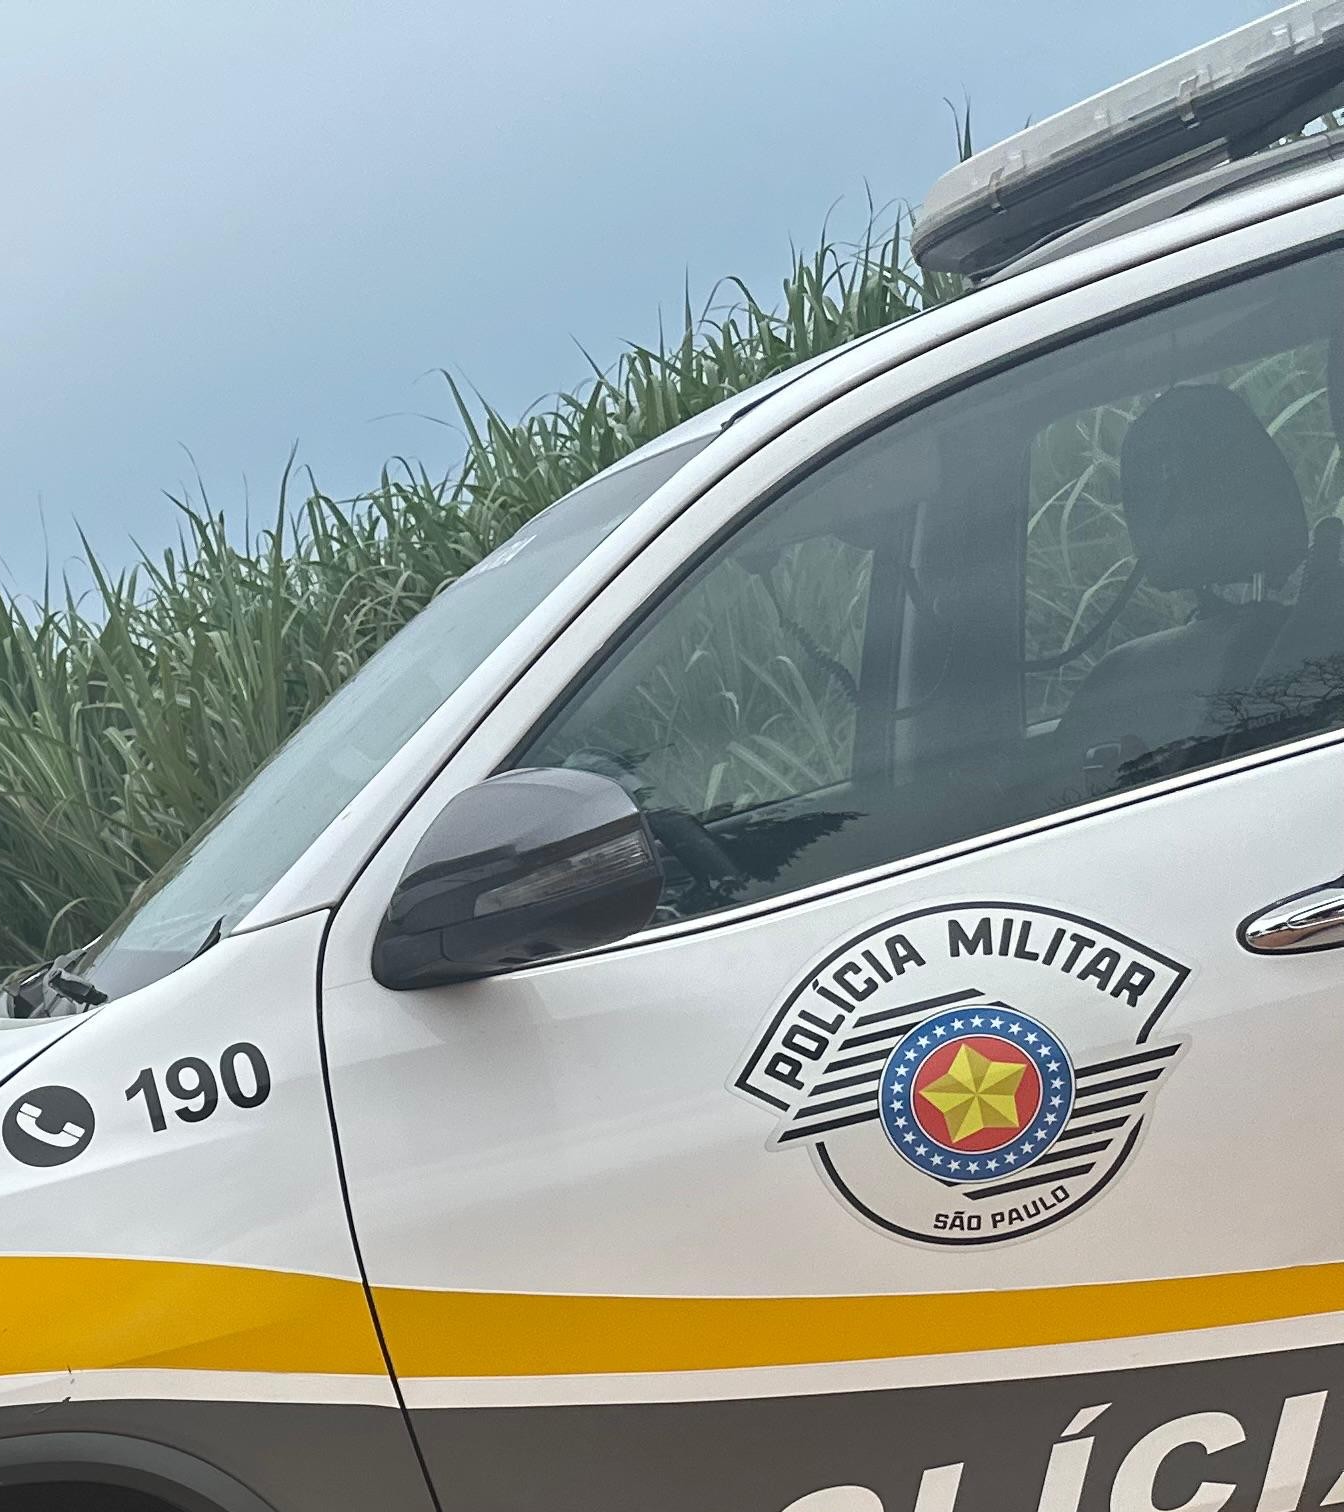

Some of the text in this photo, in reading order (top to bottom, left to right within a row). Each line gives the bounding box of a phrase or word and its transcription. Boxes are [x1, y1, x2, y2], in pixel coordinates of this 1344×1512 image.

[764, 917, 1157, 1091] POLÍCIA MILITAR
[124, 1042, 272, 1133] 190
[933, 1185, 1071, 1232] SÃO PAULO
